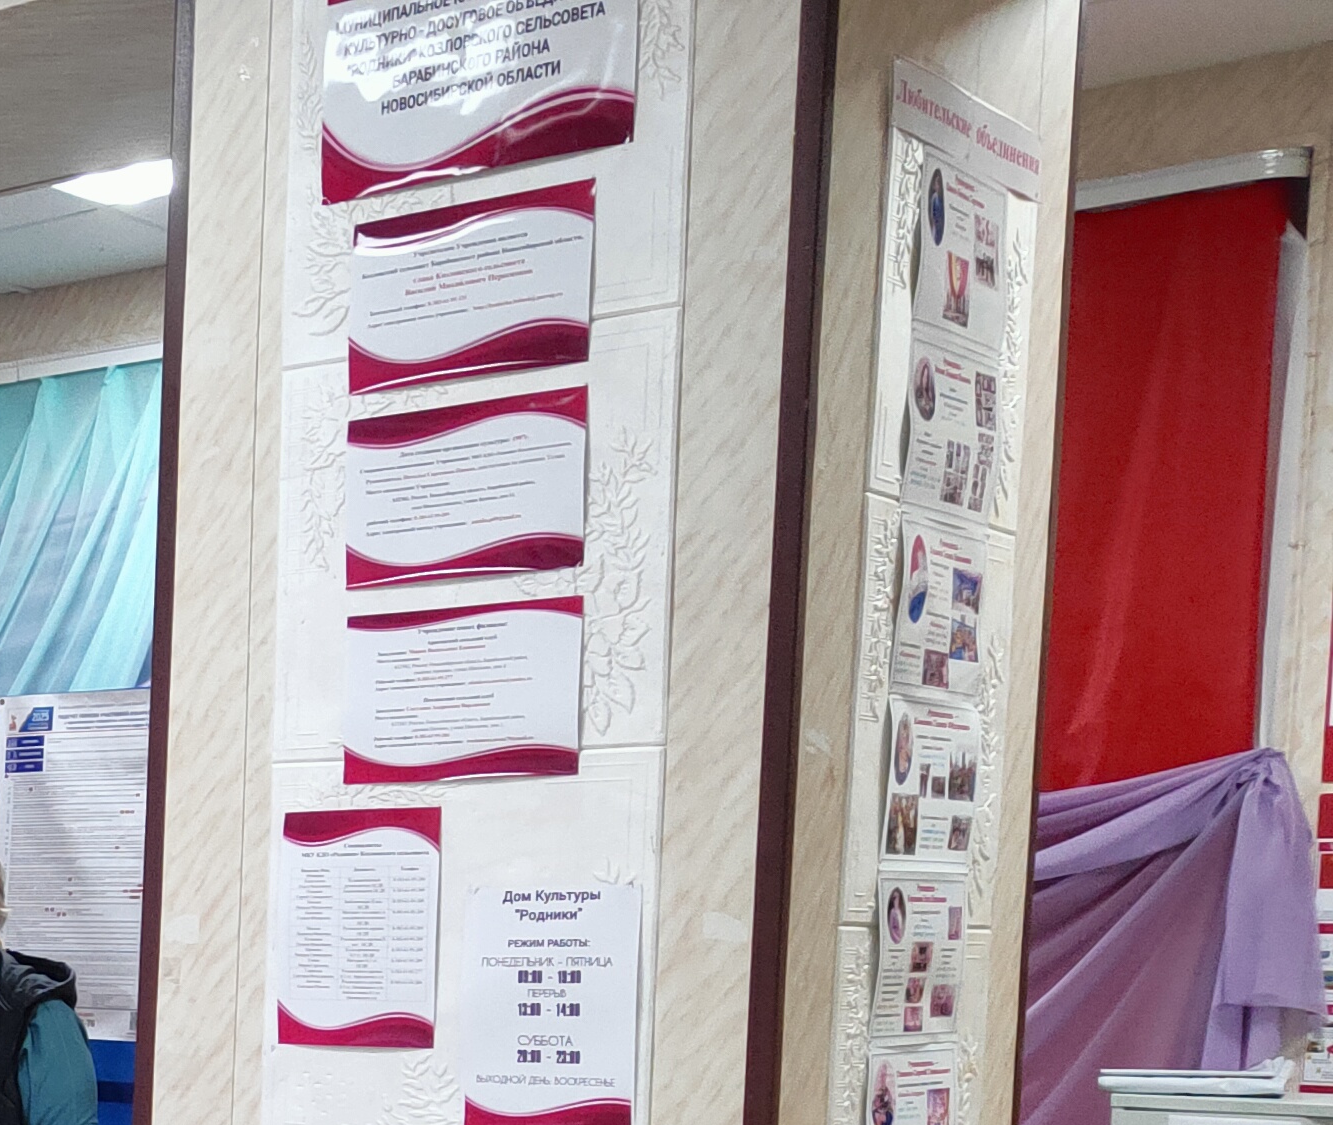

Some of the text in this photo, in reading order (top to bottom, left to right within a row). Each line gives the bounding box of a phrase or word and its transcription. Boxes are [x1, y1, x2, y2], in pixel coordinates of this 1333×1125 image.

[426, 2, 504, 38] ДОСУГОВОЕ
[516, 1, 606, 35] СЕЛЬСОВЕТА
[495, 38, 550, 64] РАЙОНА
[381, 60, 562, 115] НОВОСИБИРСКОЙ ОБЛАСТИ
[502, 890, 601, 904] Дом Культуры
[515, 907, 583, 922] "Родники"
[508, 939, 544, 947] РЕЖИМ
[481, 957, 555, 967] ПОНЕДЕЛЬНИК
[566, 957, 613, 967] ПЯТНИЦА
[527, 989, 567, 998] ПЕРЕРЫВ
[517, 1035, 573, 1046] СУББОТА
